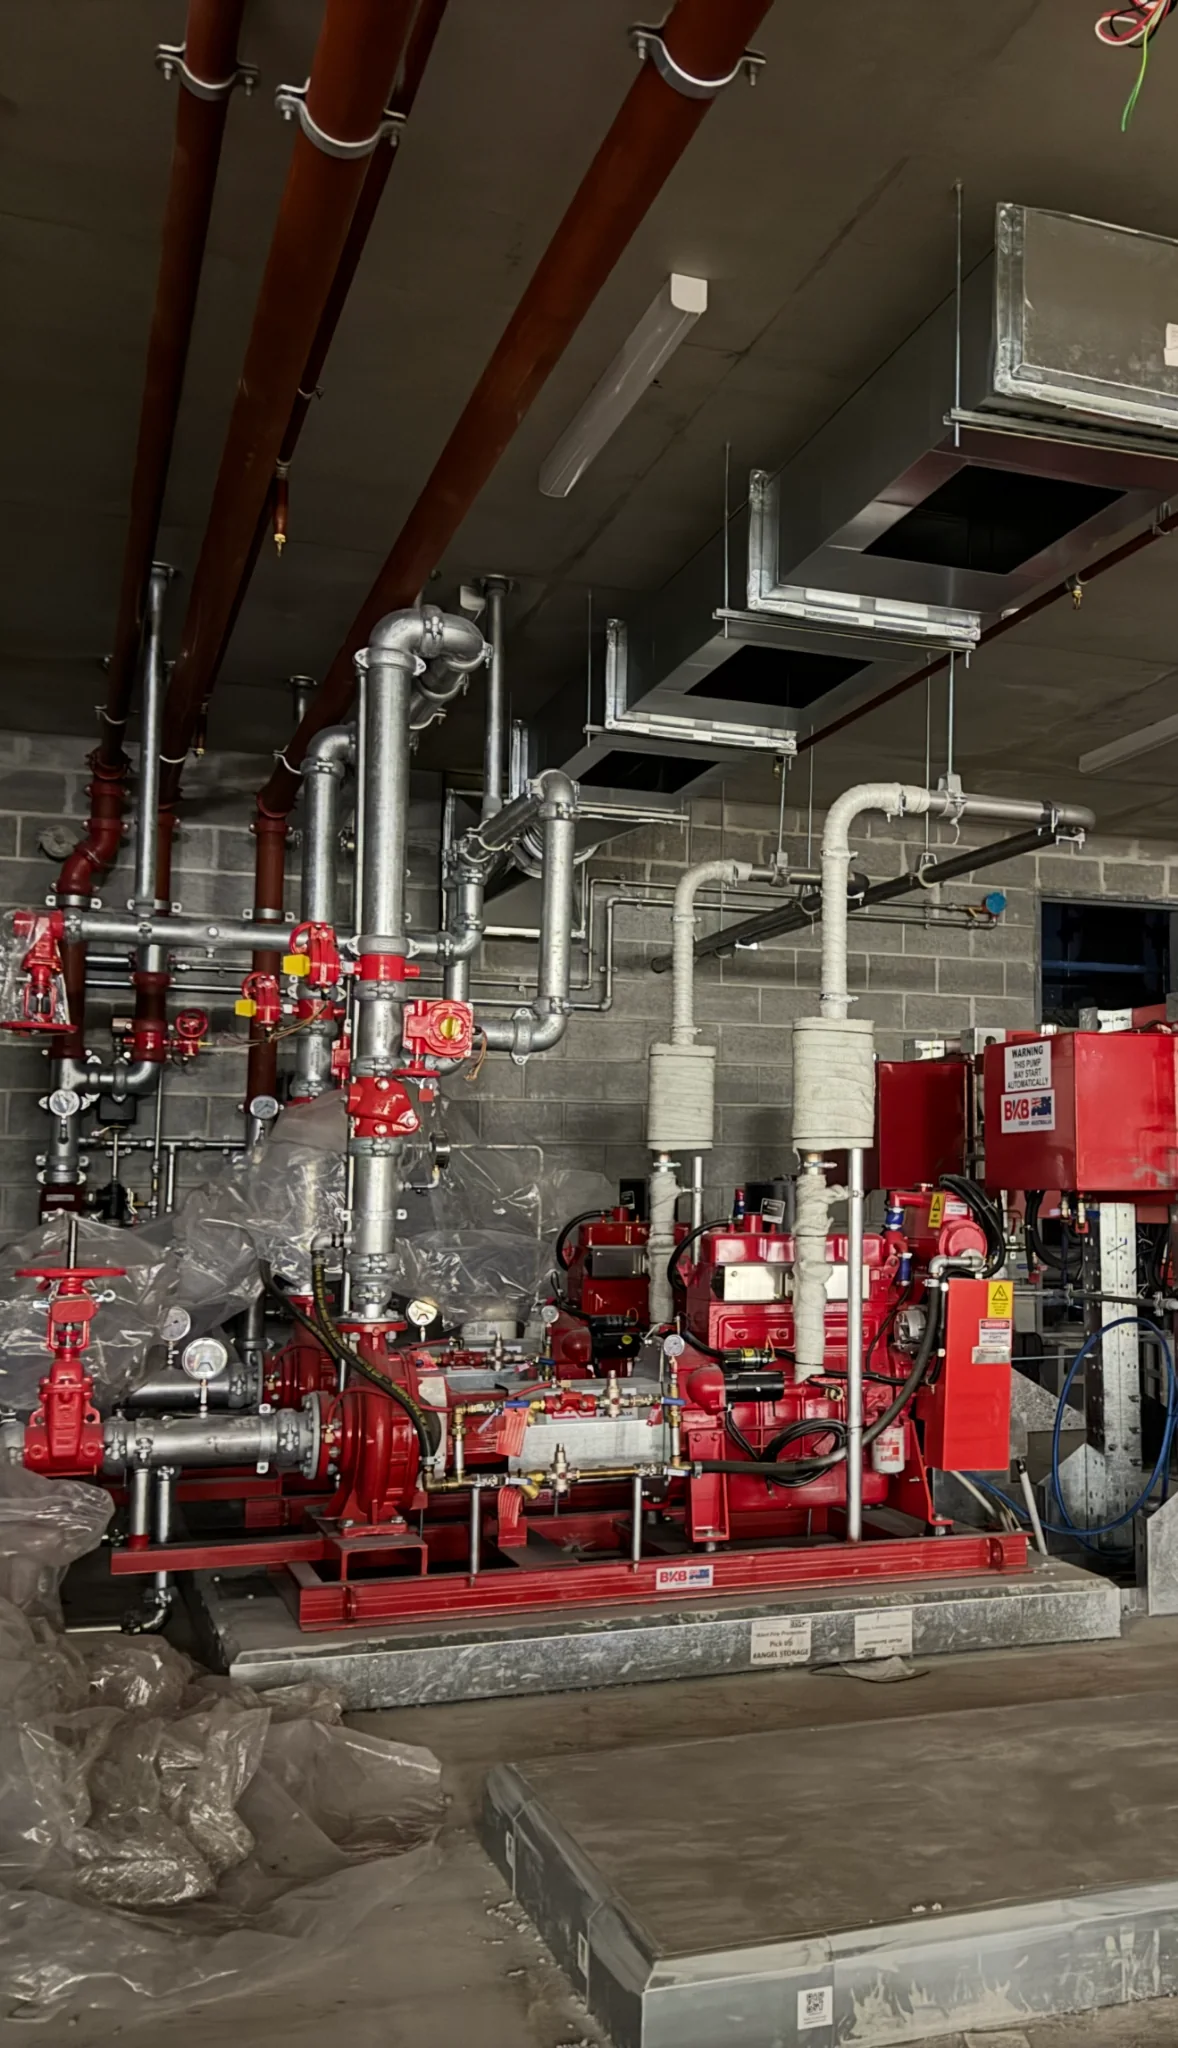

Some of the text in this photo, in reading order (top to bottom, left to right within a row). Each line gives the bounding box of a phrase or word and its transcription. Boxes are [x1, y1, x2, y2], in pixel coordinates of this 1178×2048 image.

[1012, 1045, 1043, 1058] WARNING
[1014, 1058, 1041, 1069] THIS PUMP
[1013, 1068, 1041, 1079] MAY START
[1008, 1077, 1048, 1089] AUTOMATICALLY
[1004, 1099, 1029, 1120] BKB
[660, 1570, 687, 1582] BKB
[780, 1649, 809, 1658] STORAGE
